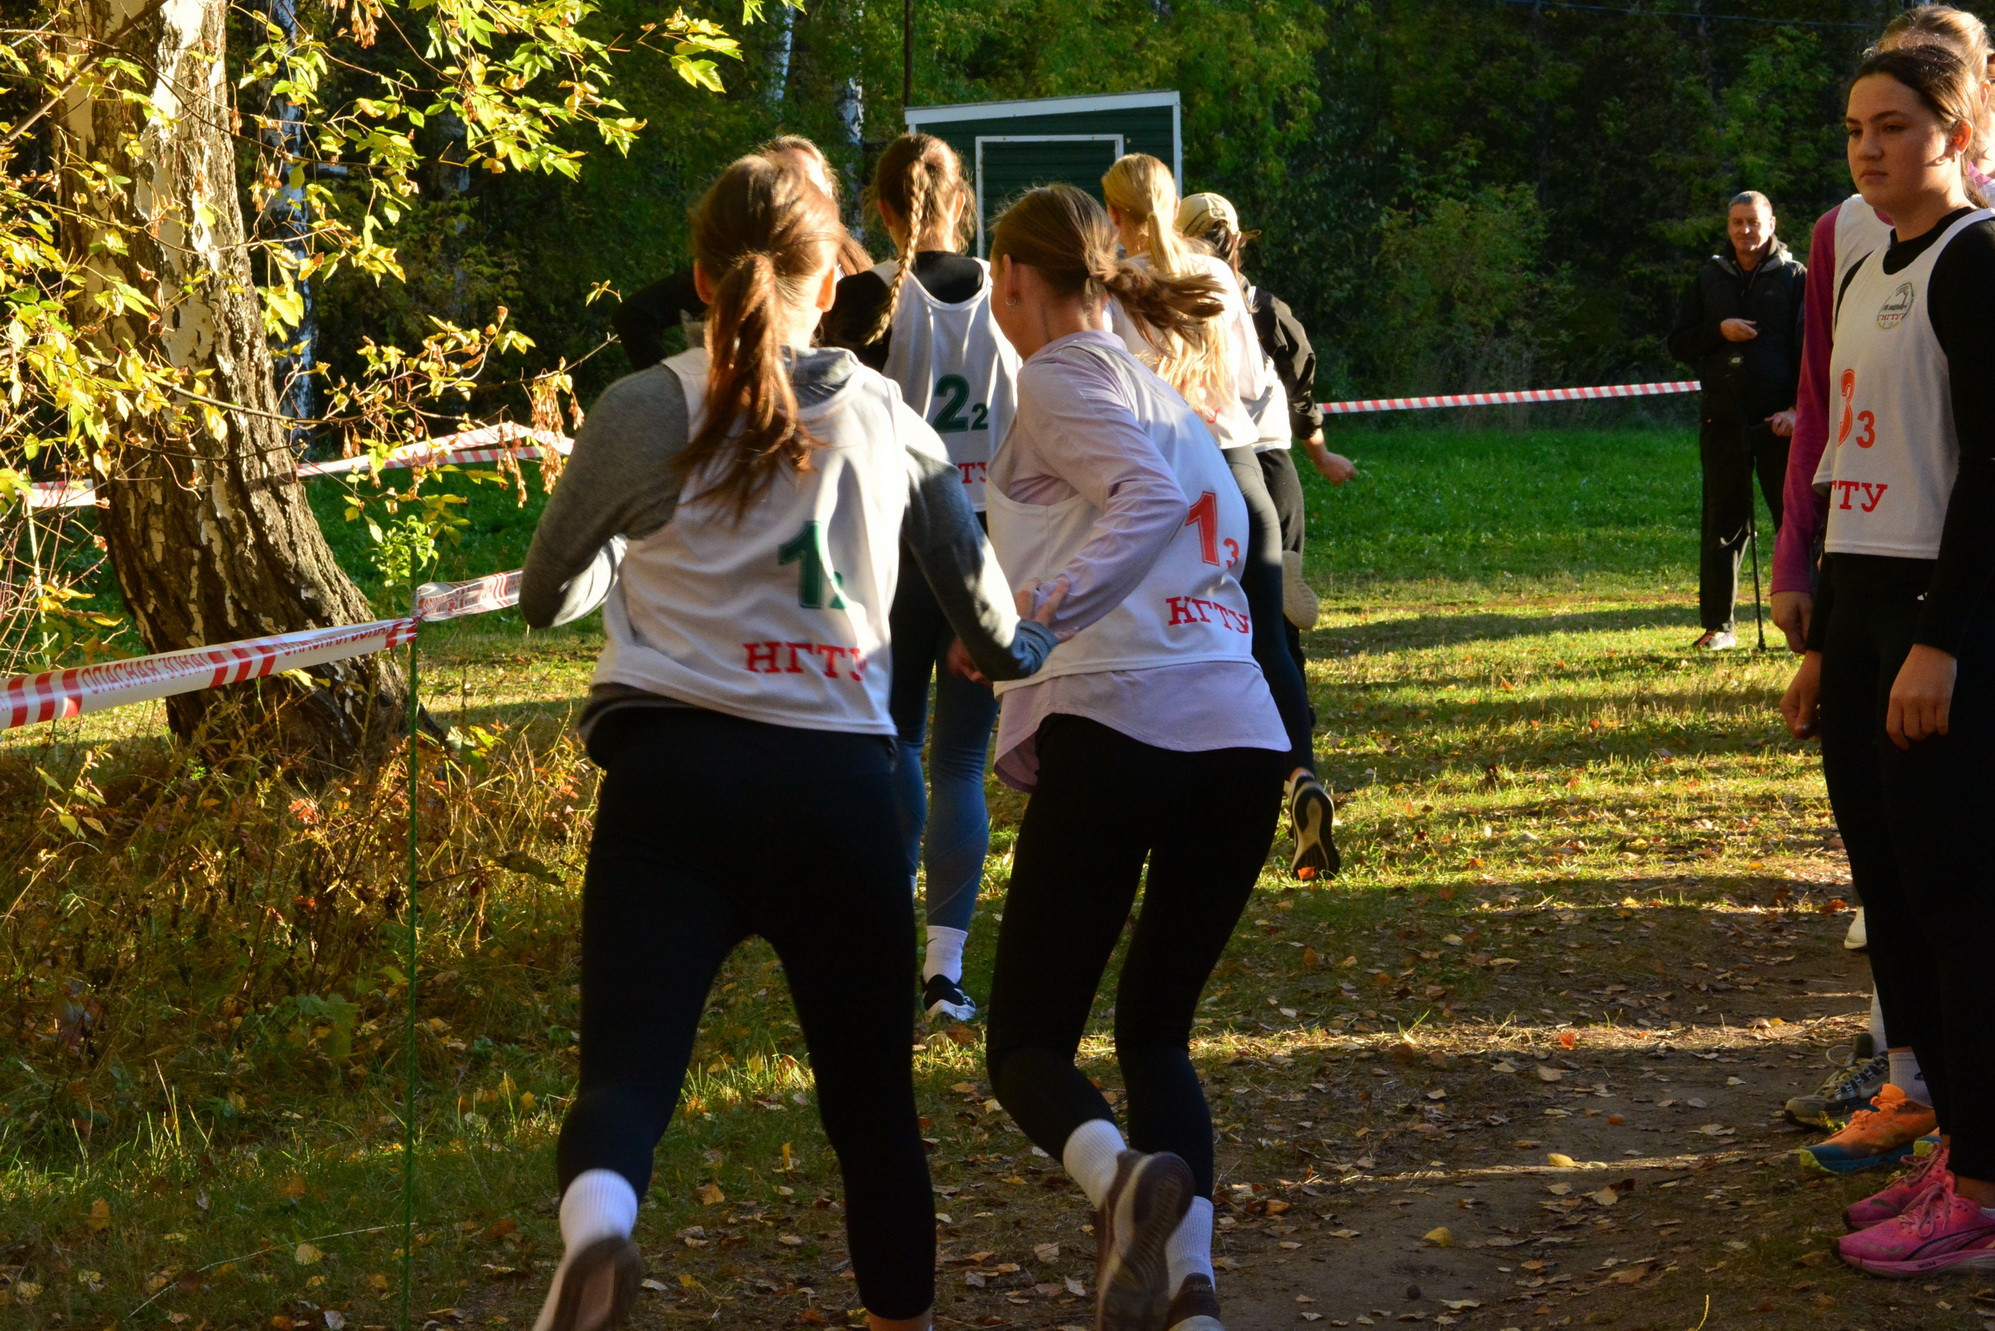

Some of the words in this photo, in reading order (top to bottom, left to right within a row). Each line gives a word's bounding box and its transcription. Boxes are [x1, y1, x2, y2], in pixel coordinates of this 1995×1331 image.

[1165, 596, 1250, 634] НГТУ
[81, 659, 165, 695] ОПАСНАЯ
[742, 641, 869, 682] НГТУ
